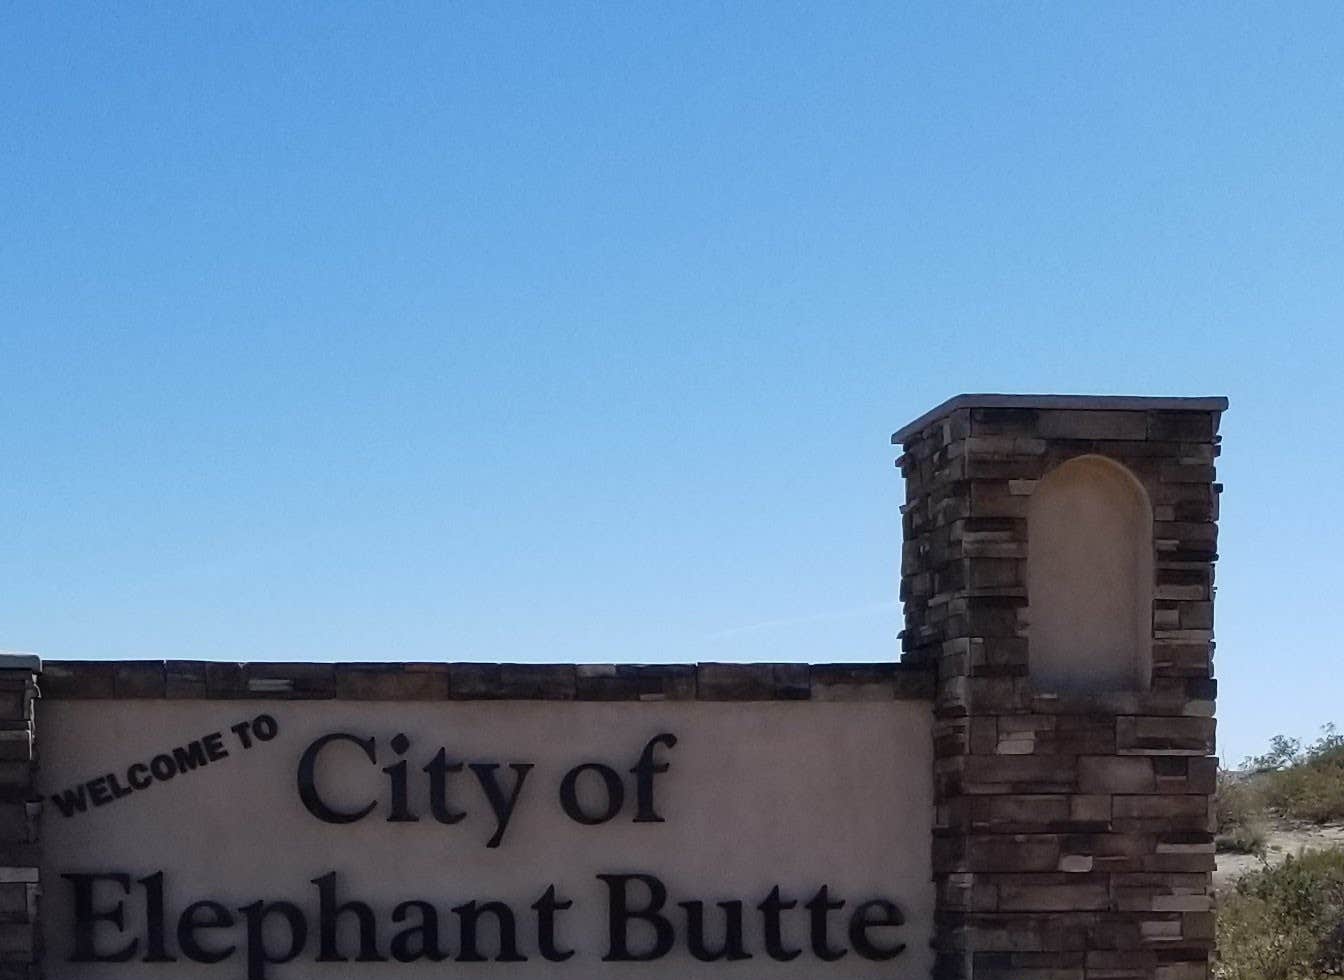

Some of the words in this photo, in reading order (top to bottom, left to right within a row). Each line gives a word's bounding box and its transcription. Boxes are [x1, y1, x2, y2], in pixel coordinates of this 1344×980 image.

[51, 731, 229, 818] WELCOME
[231, 714, 278, 749] TO
[297, 732, 535, 848] City
[559, 732, 678, 825] of
[596, 873, 906, 963] Butte
